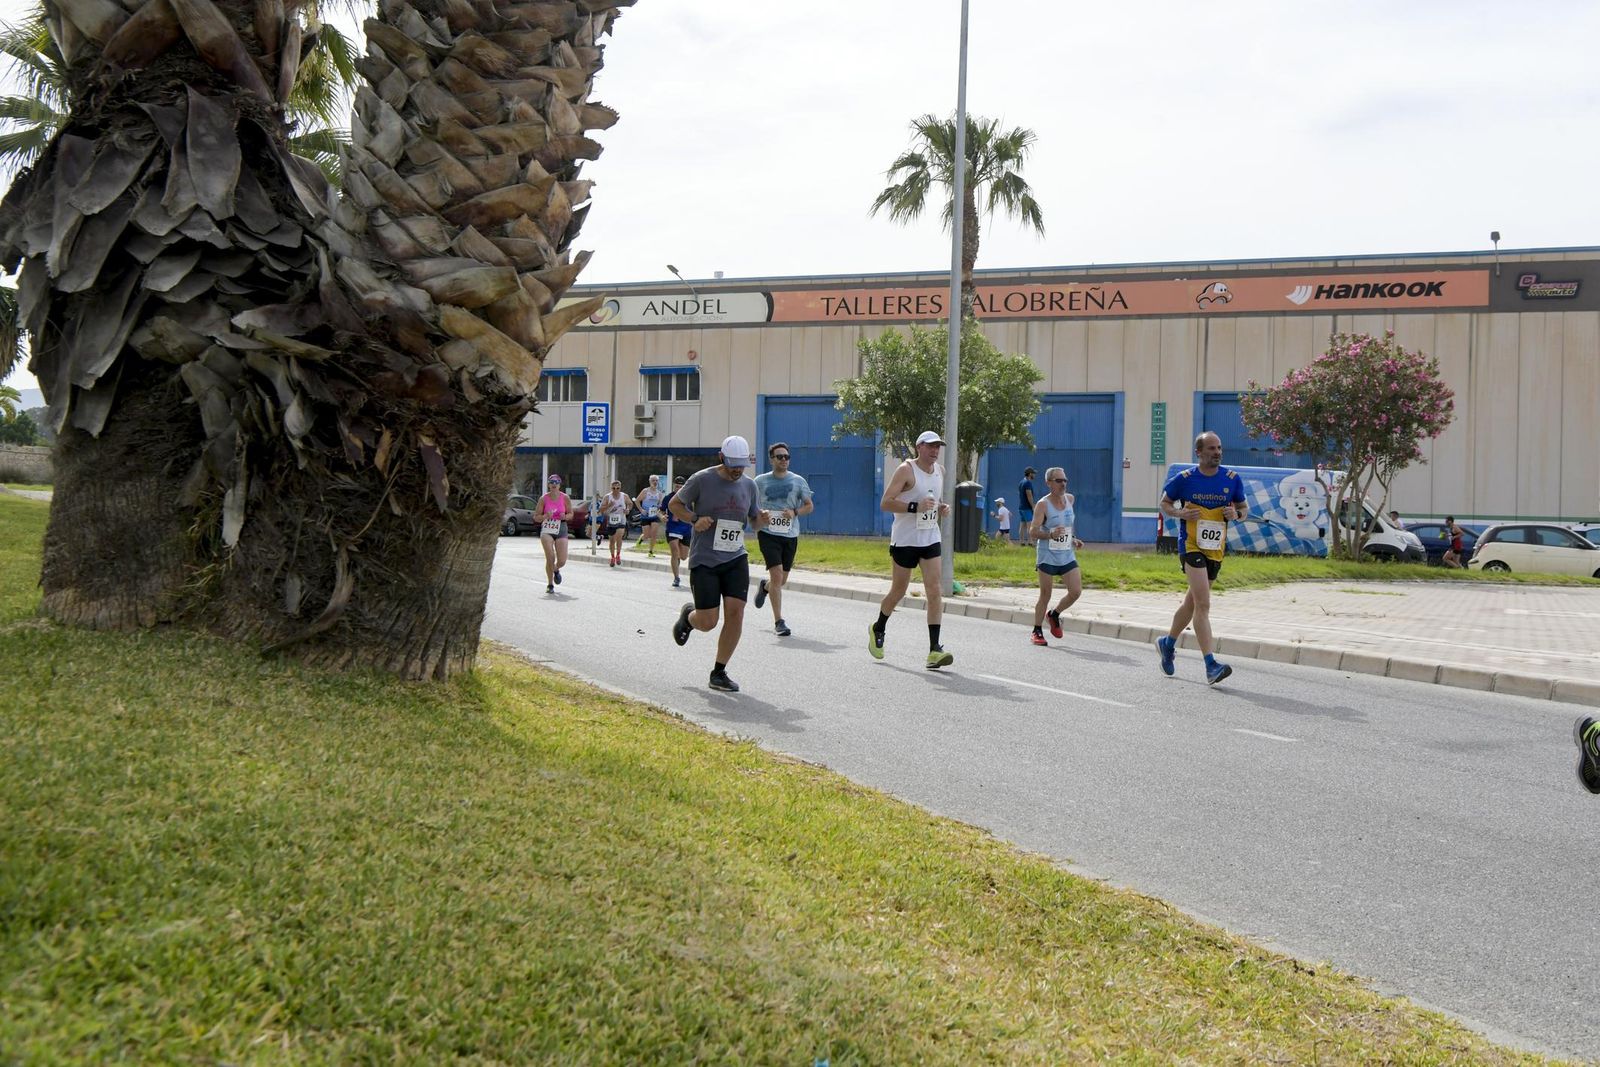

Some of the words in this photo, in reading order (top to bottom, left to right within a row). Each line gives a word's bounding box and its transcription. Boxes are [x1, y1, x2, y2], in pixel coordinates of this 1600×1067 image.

[642, 299, 727, 315] ANDEL
[820, 294, 943, 316] TALLERES
[972, 286, 1129, 313] ALOBREÑA
[1192, 493, 1227, 501] agustinos
[721, 529, 741, 541] 567
[1201, 529, 1222, 541] 602
